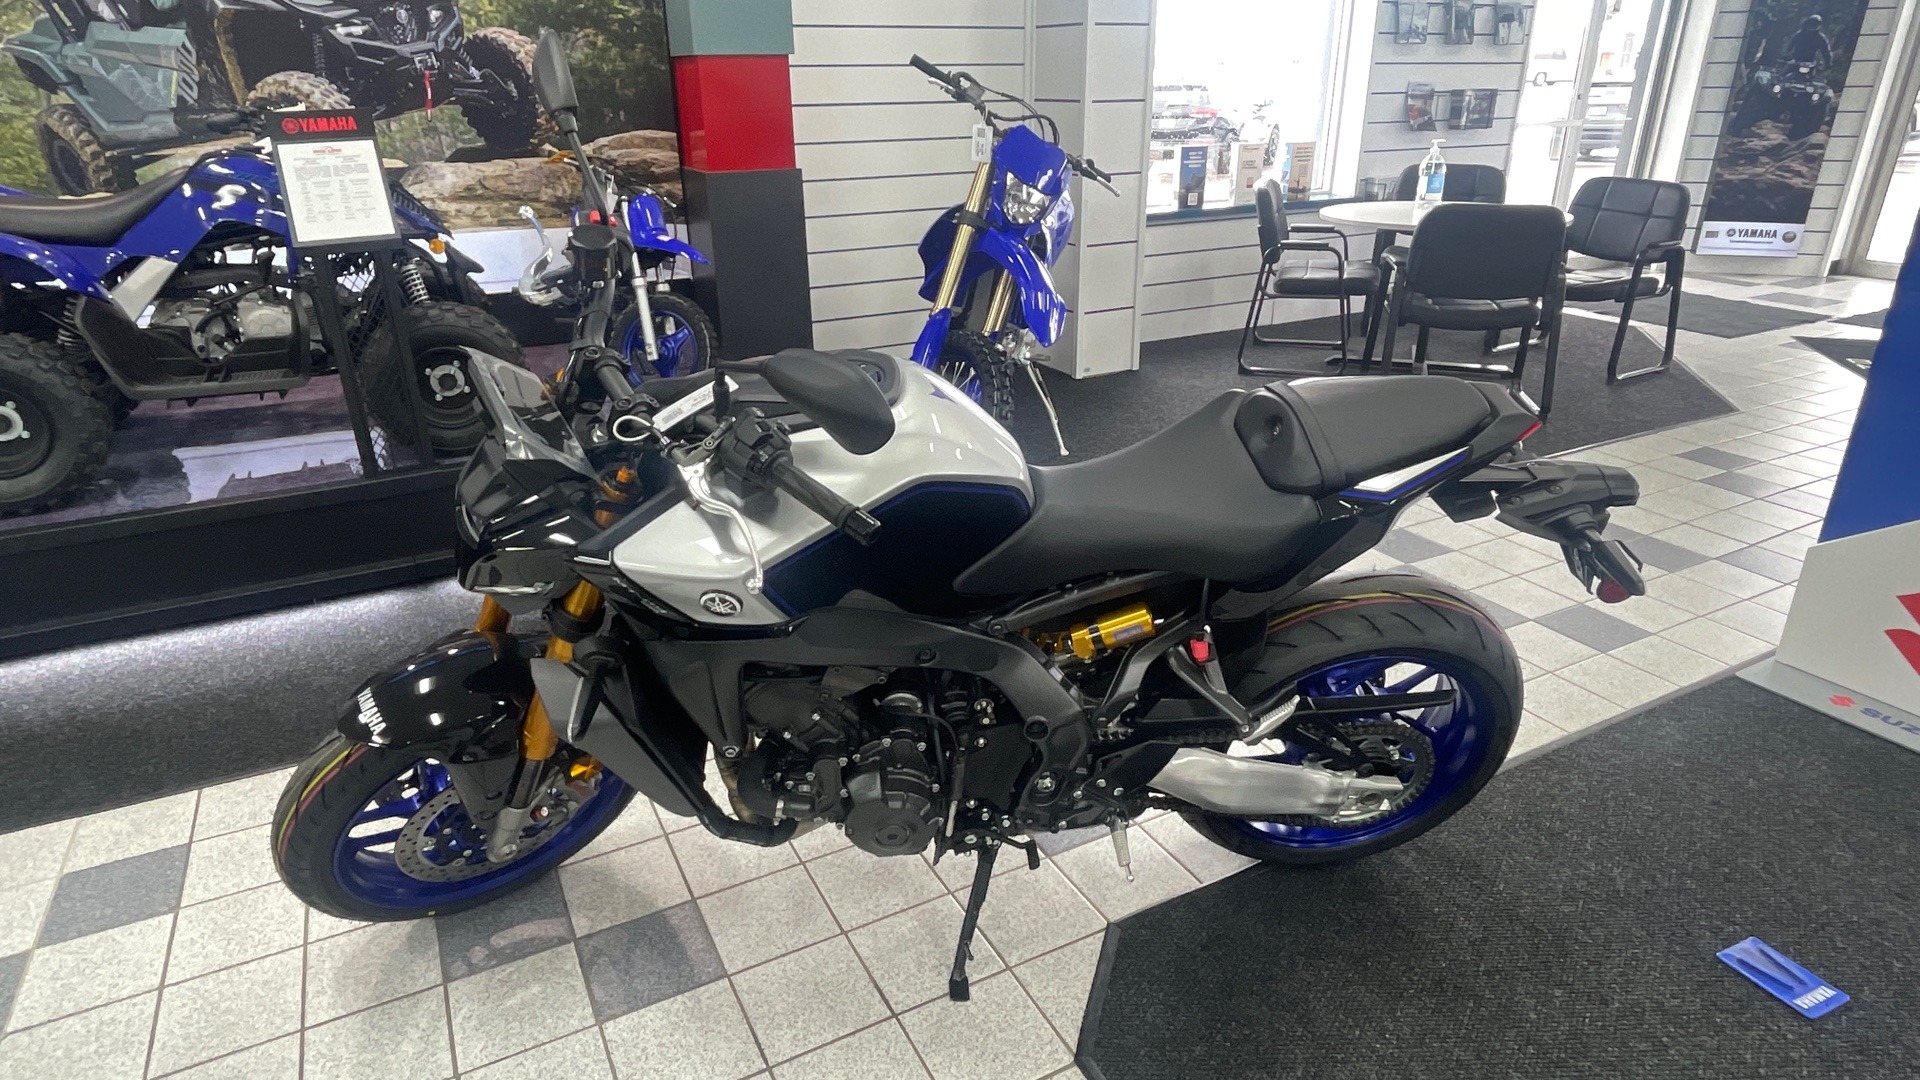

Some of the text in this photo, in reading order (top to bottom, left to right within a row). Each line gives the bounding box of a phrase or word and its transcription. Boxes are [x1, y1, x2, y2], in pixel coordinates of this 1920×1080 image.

[299, 116, 357, 132] YAMAHA
[1738, 228, 1778, 239] YAMAHA
[357, 687, 387, 735] YAMAHA
[1792, 985, 1837, 1009] YAMAHA
